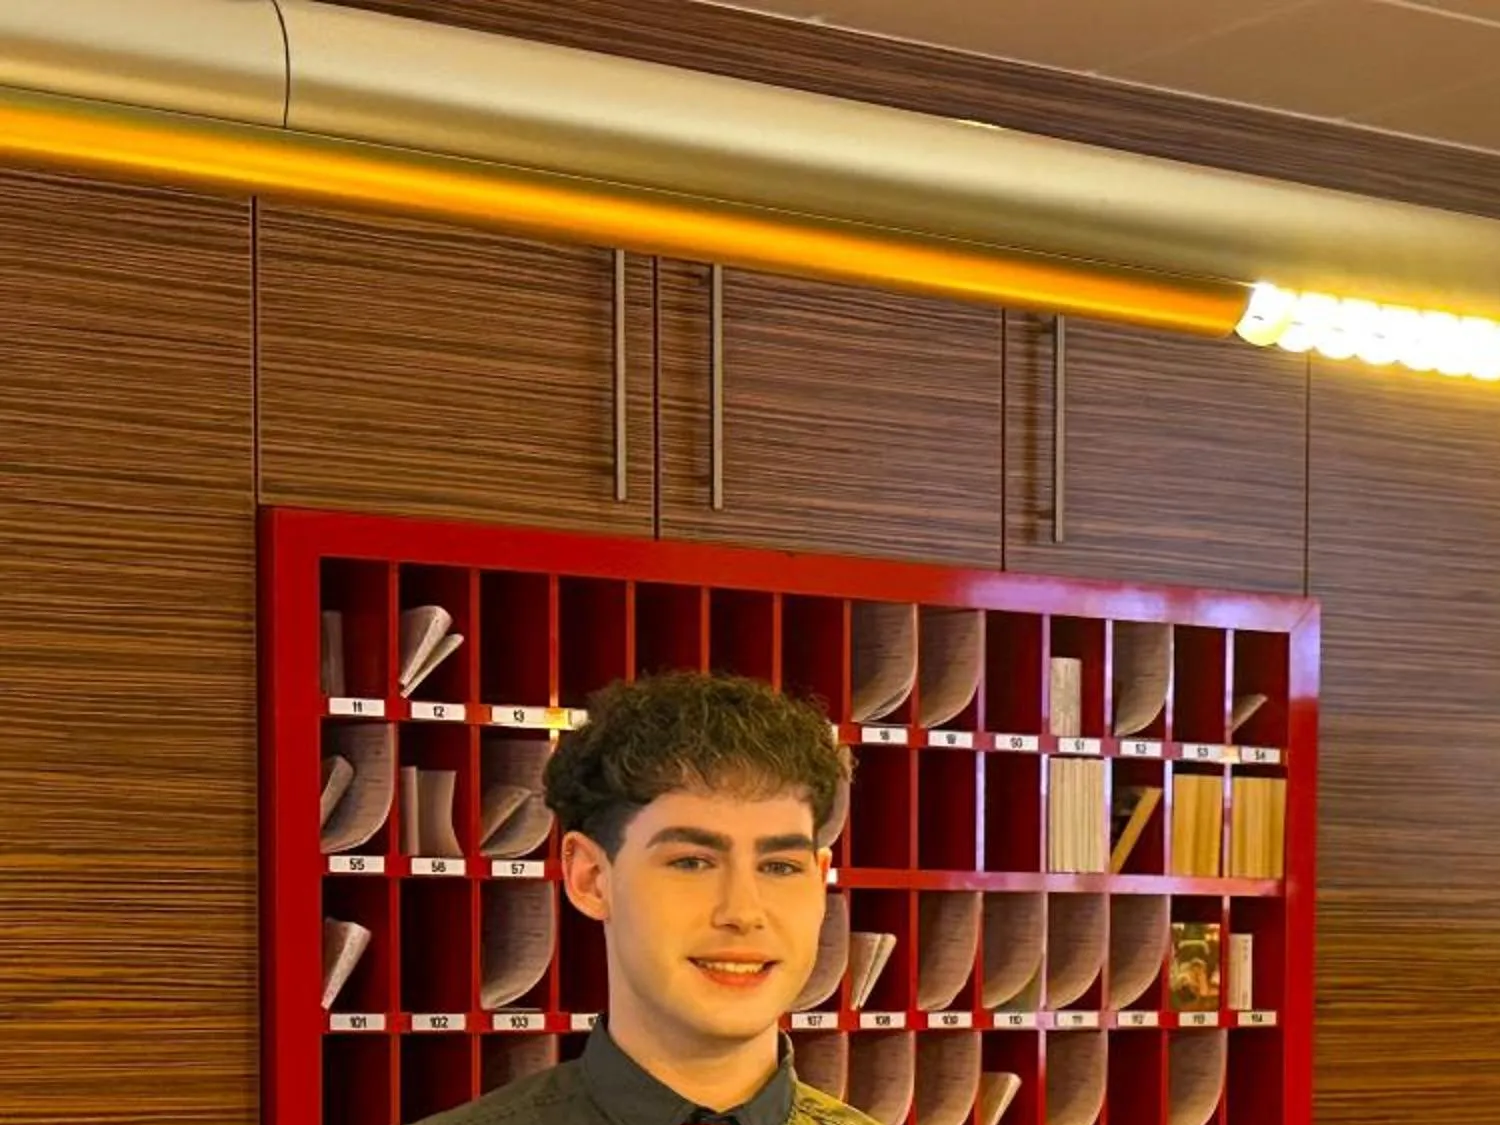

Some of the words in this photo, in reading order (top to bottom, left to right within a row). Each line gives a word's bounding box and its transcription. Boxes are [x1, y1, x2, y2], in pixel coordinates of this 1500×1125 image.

[354, 702, 362, 712] 11
[434, 706, 444, 717] 12
[514, 710, 524, 720] 13
[350, 856, 364, 870] 55
[432, 859, 446, 872] 56
[512, 864, 524, 874] 57
[350, 1017, 367, 1028] 101
[430, 1017, 448, 1028] 102
[510, 1017, 528, 1028] 103
[808, 1015, 822, 1025] 107
[876, 1016, 890, 1025] 108
[943, 1015, 958, 1025] 109
[1009, 1015, 1022, 1025] 110
[1073, 1015, 1083, 1023] 111
[1252, 1014, 1263, 1022] 114
